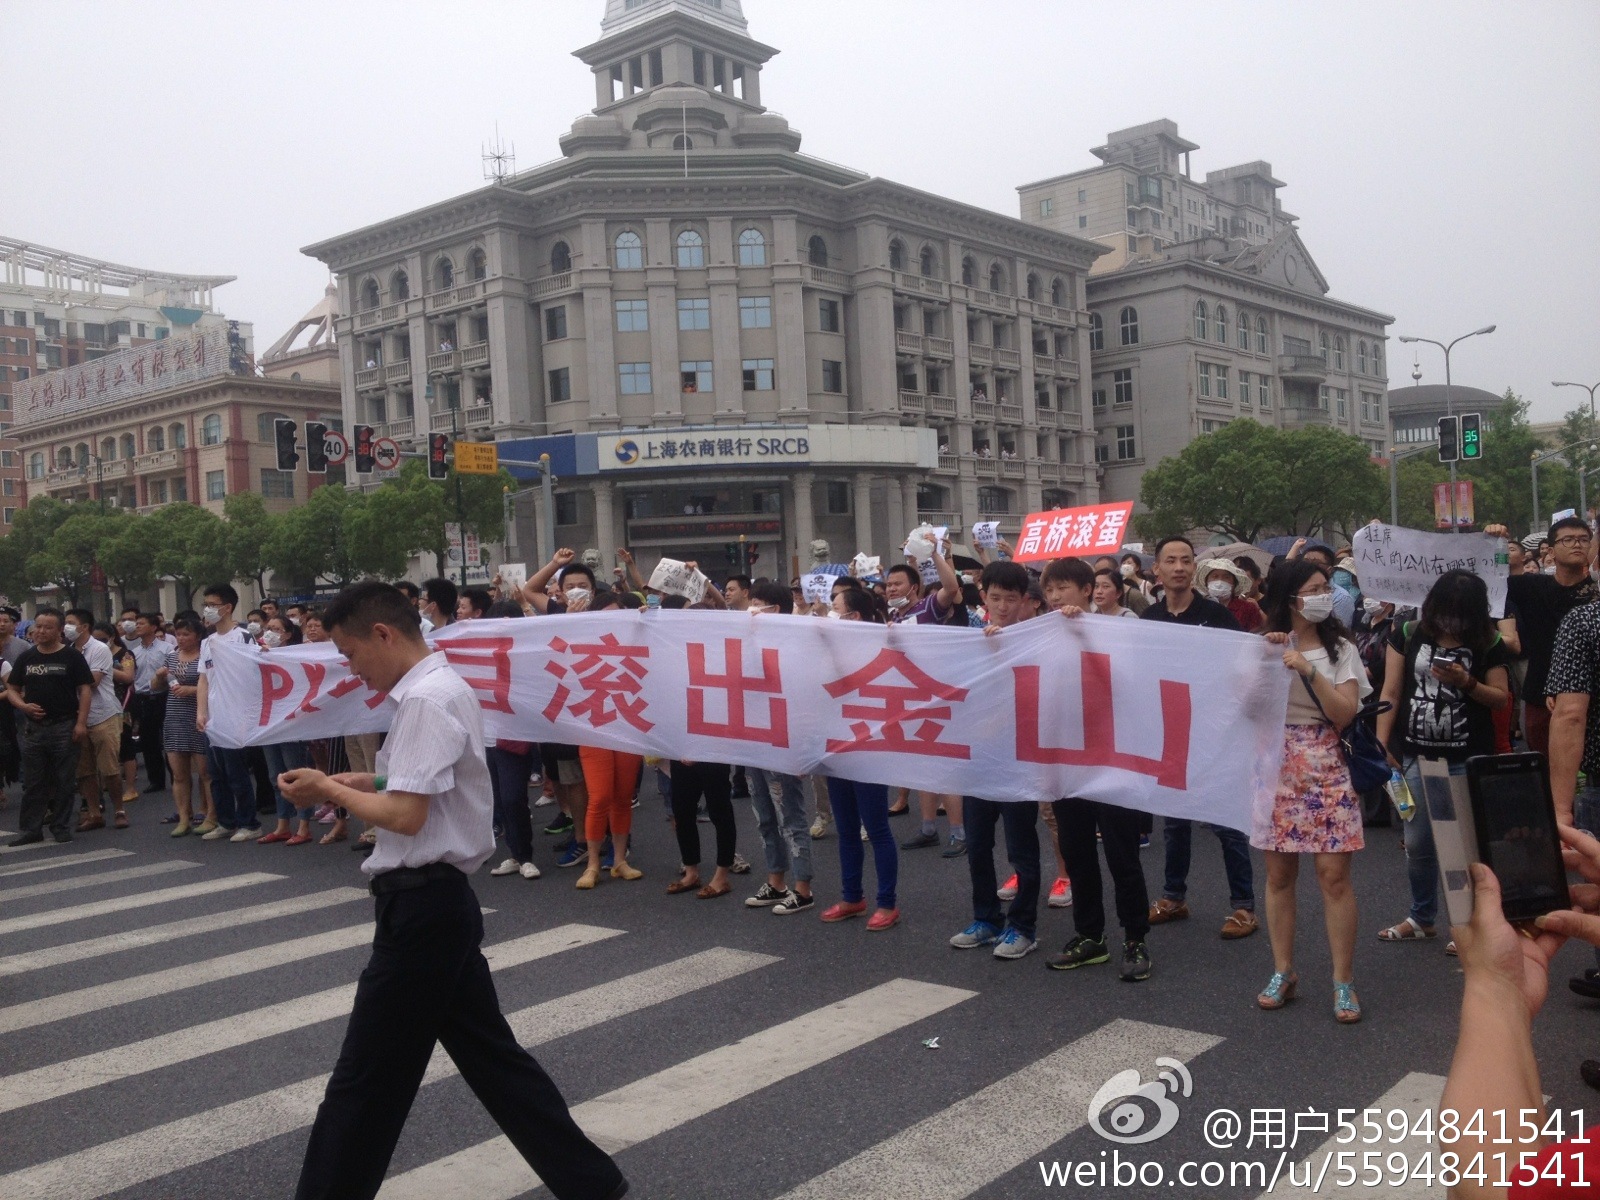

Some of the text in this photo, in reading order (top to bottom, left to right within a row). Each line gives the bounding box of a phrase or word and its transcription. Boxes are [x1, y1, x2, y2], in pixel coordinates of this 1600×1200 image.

[1464, 429, 1478, 442] 35
[325, 441, 341, 455] 40
[641, 437, 810, 460] 上海农商银行 SRCB
[1018, 509, 1127, 556] 高桥滚蛋
[1363, 525, 1392, 548] 习主席
[258, 633, 1192, 791] PX目滚出金山
